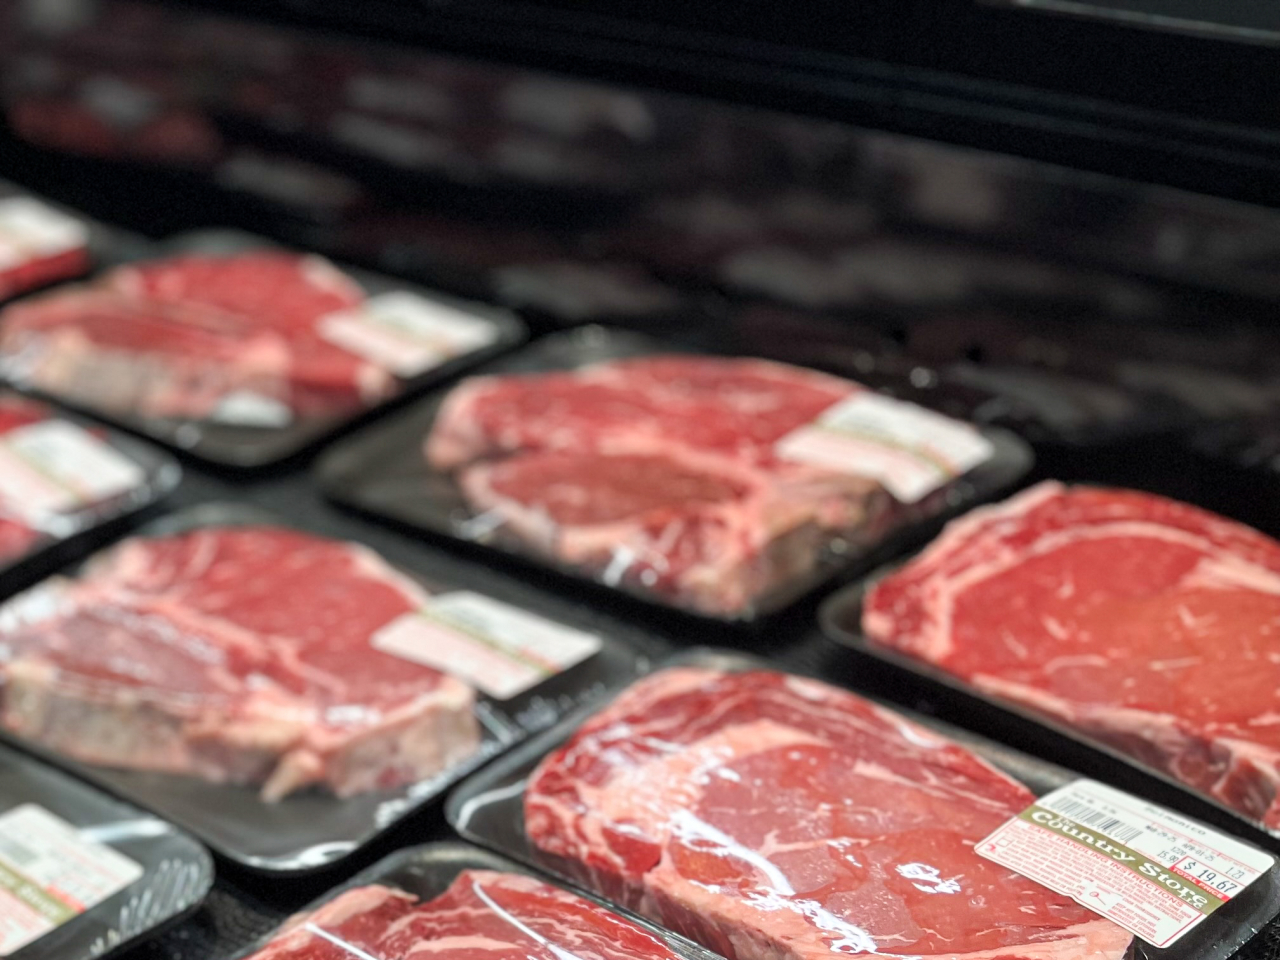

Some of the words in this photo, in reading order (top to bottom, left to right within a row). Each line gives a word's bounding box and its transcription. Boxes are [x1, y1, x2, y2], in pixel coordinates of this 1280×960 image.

[1054, 816, 1076, 827] The
[1028, 809, 1137, 864] Country
[1136, 861, 1211, 906] Store
[1156, 849, 1180, 863] 15.99
[1169, 846, 1187, 856] 1220
[1028, 825, 1055, 838] SAFE
[1056, 837, 1109, 863] HANDLING
[1108, 862, 1185, 907] INSTRUCTIONS
[1223, 866, 1247, 879] 1.23
[1170, 867, 1198, 883] TOTAL
[1197, 882, 1225, 898] PRICE
[1181, 860, 1198, 870] $
[1195, 868, 1238, 893] 19.67
[1175, 893, 1204, 909] LLC
